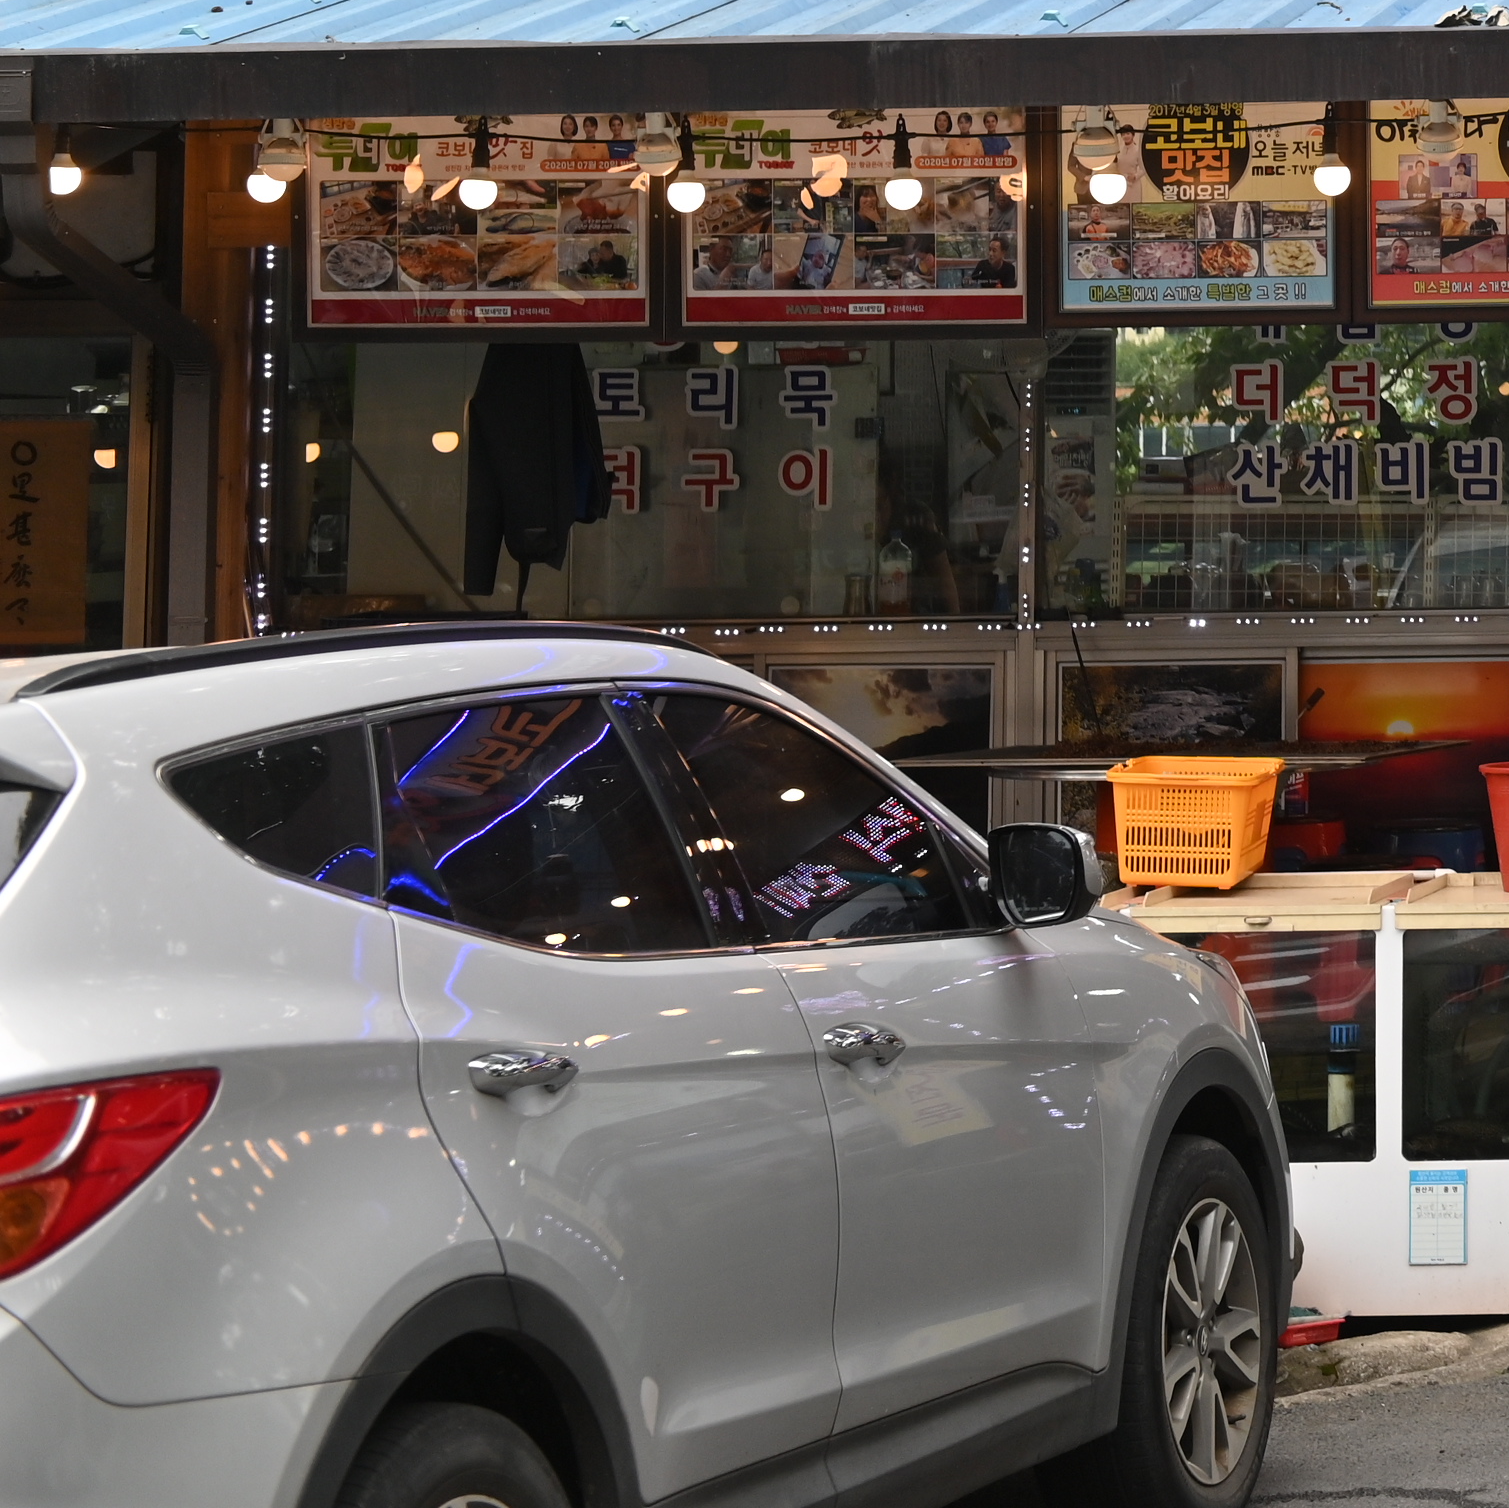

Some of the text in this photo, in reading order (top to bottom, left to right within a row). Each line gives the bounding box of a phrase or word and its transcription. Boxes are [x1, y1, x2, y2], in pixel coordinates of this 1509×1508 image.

[1150, 102, 1245, 117] 2017년 4월 3일 방영
[1145, 117, 1247, 150] 코보네
[314, 123, 419, 172] 투데이
[695, 119, 791, 170] 투데이
[1252, 140, 1289, 162] 오늘
[544, 161, 619, 170] 2020년 07월 20일
[757, 160, 795, 170] TODAY
[919, 156, 1013, 166] 2020년 07월 20일 방영
[1161, 150, 1231, 184] 맛집
[1162, 184, 1230, 201] 황어요리
[1089, 282, 1307, 303] 매스컴에서 소개한 특별한 그 곳 !!
[1413, 279, 1473, 294] 매스컴에서
[413, 307, 449, 318] NAVER
[477, 307, 509, 317] 코보네맛집
[519, 307, 551, 317] 검색하세요
[786, 304, 823, 315] NAVER
[851, 304, 883, 314] 코보네맛집
[893, 304, 925, 314] 검색하세요
[595, 367, 838, 428] 토리묵
[602, 448, 829, 510] 덕구이
